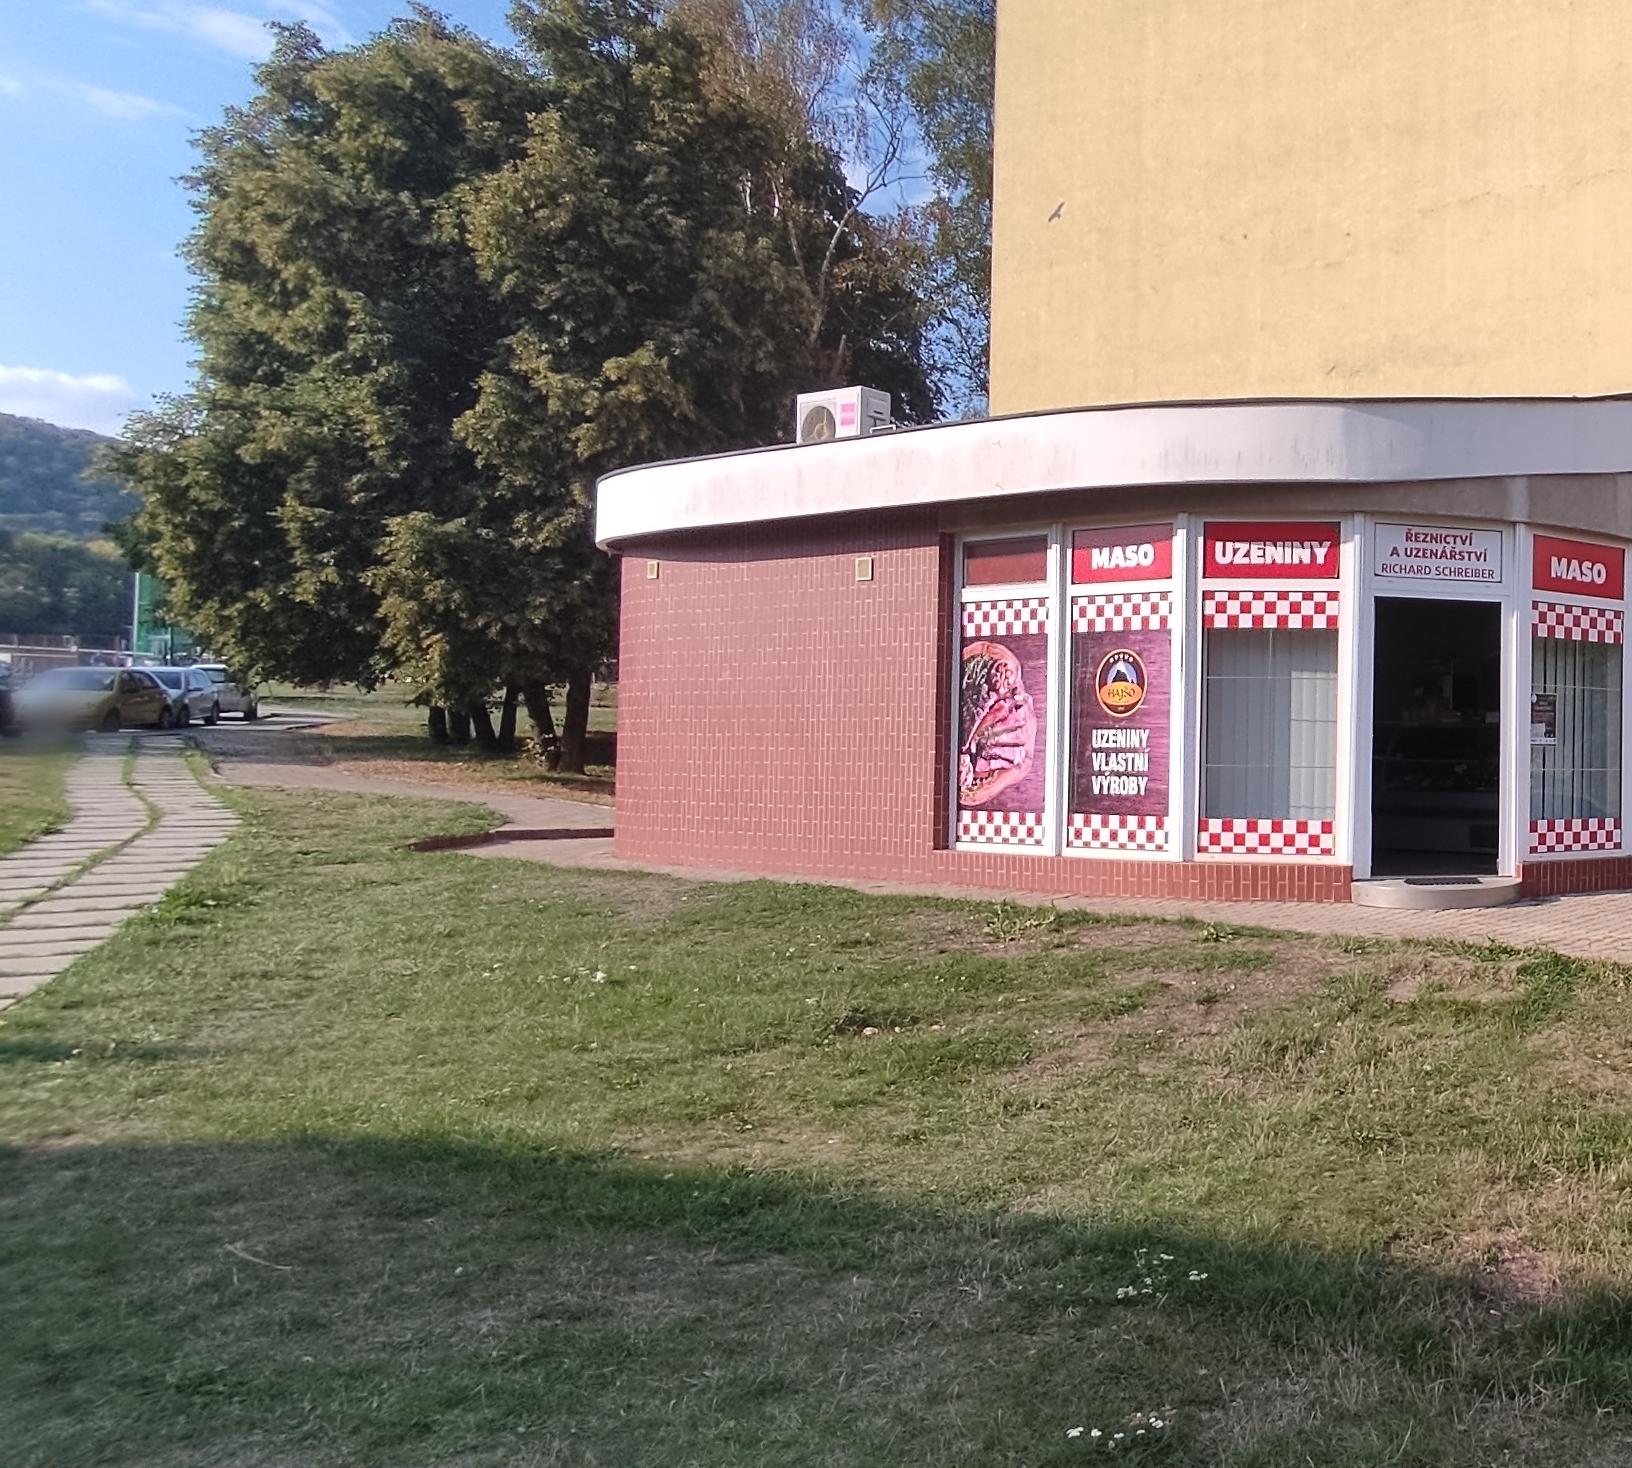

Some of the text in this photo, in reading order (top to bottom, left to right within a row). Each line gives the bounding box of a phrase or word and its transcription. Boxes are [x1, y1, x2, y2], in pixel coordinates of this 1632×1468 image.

[1405, 528, 1473, 547] ŘEZNICTVÍ
[1091, 543, 1155, 570] MASO
[1214, 540, 1332, 566] UZENINY
[1390, 545, 1488, 563] A UZENÁŘSTVÍ
[1381, 563, 1495, 580] RICHARD SCHREIBER
[1550, 555, 1607, 585] MASO
[1091, 728, 1150, 748] UZENINY
[1091, 748, 1150, 772] VLASTNÍ
[1091, 771, 1149, 796] VÝROBY
